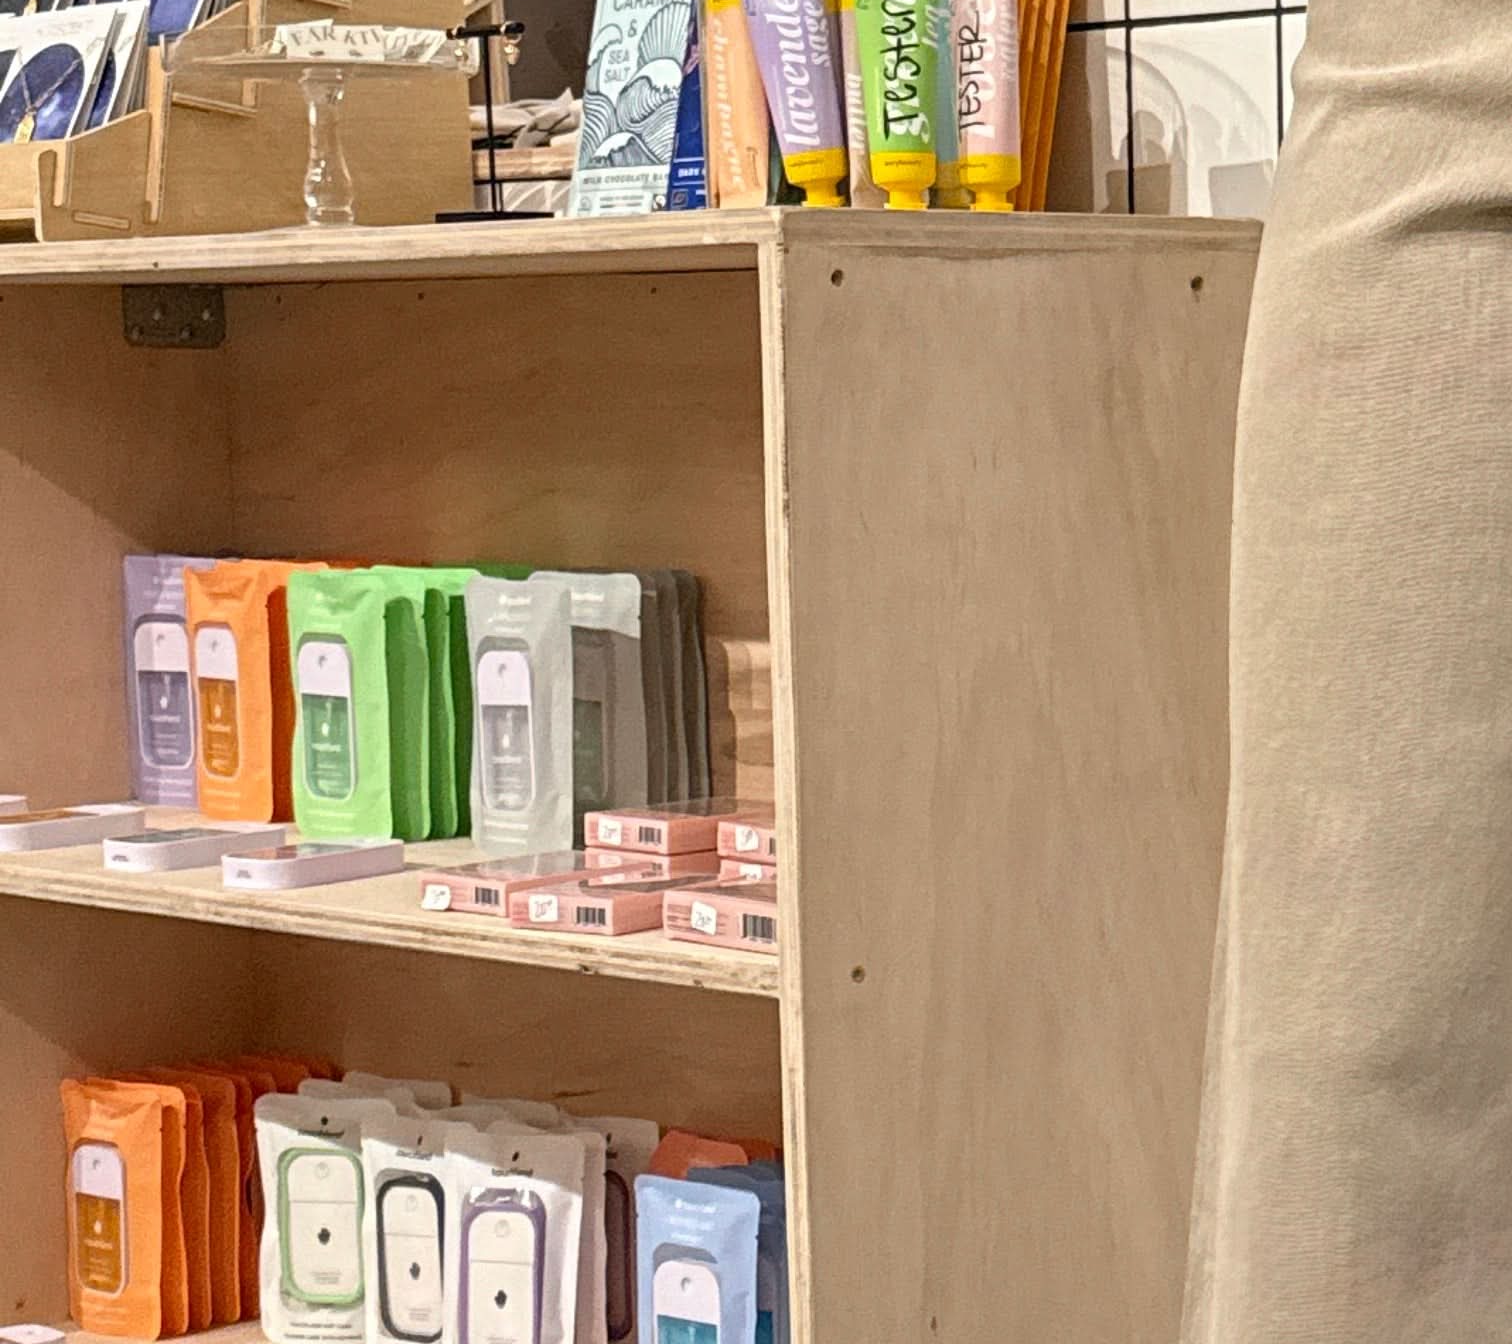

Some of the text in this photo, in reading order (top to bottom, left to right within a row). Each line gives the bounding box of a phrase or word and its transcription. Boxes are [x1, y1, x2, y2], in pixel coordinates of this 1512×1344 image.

[627, 18, 638, 38] &
[804, 1, 830, 68] sage
[607, 49, 631, 65] SEA
[603, 66, 631, 84] SALT
[957, 10, 988, 144] TESTER
